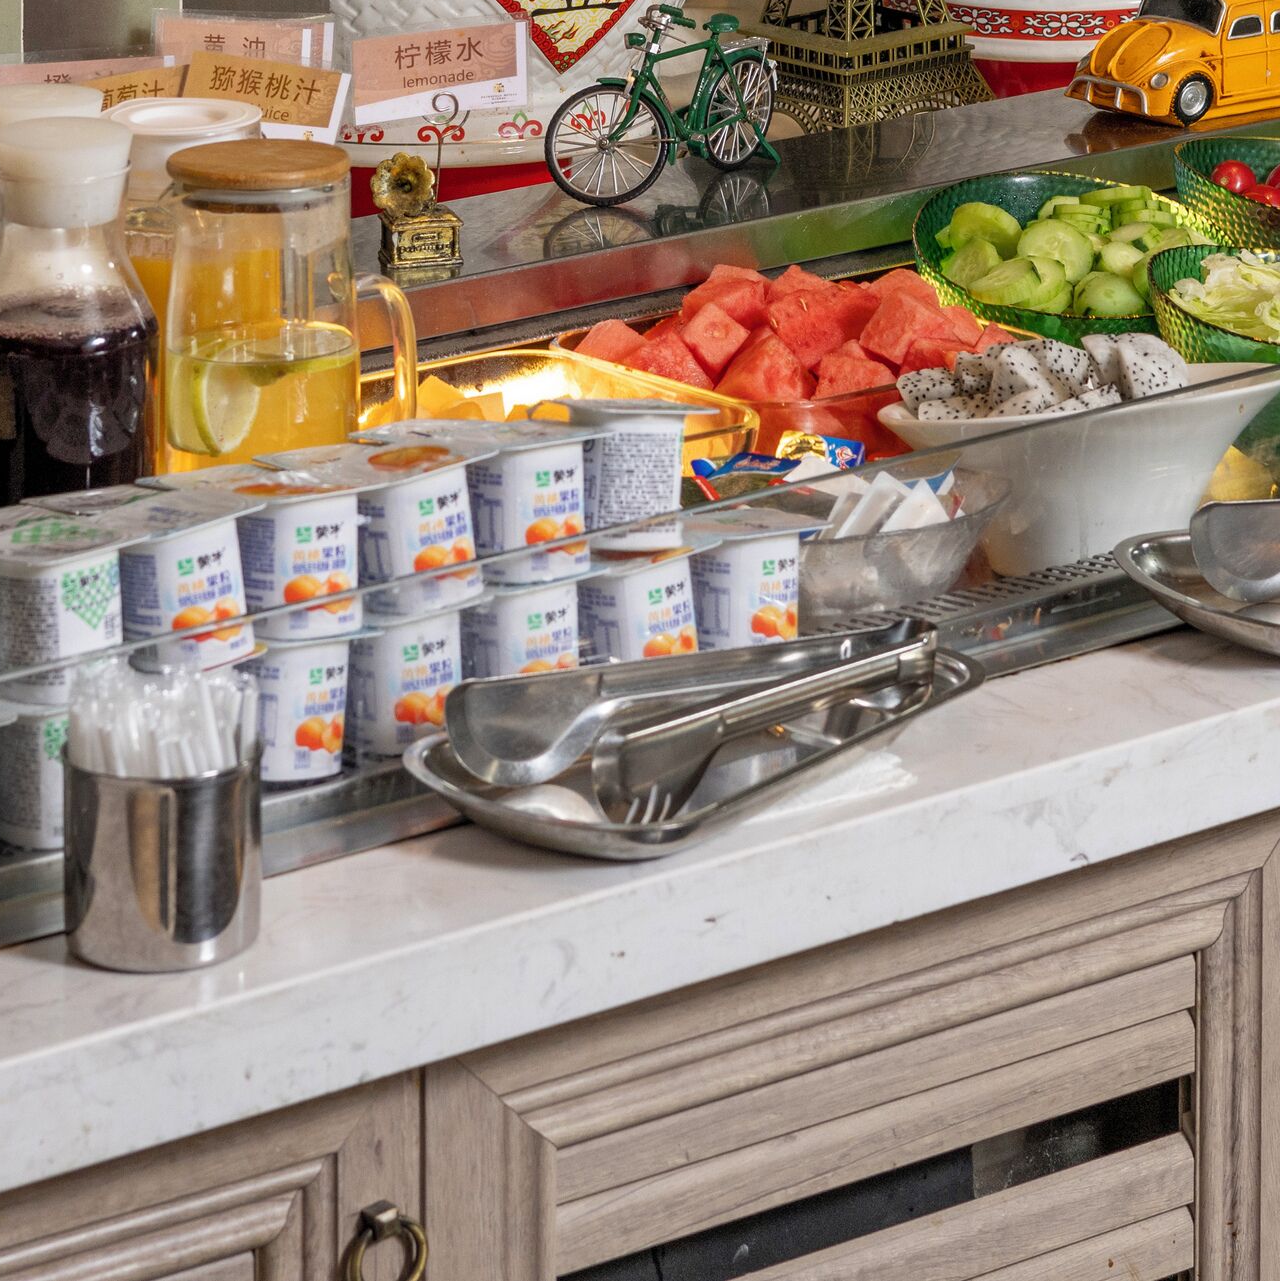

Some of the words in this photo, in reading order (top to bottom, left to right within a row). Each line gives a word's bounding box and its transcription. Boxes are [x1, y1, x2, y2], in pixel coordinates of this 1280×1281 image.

[394, 36, 484, 71] 柠檬水
[208, 64, 322, 106] 猕猴桃汁
[402, 69, 475, 89] lemonade
[257, 103, 290, 122] uice
